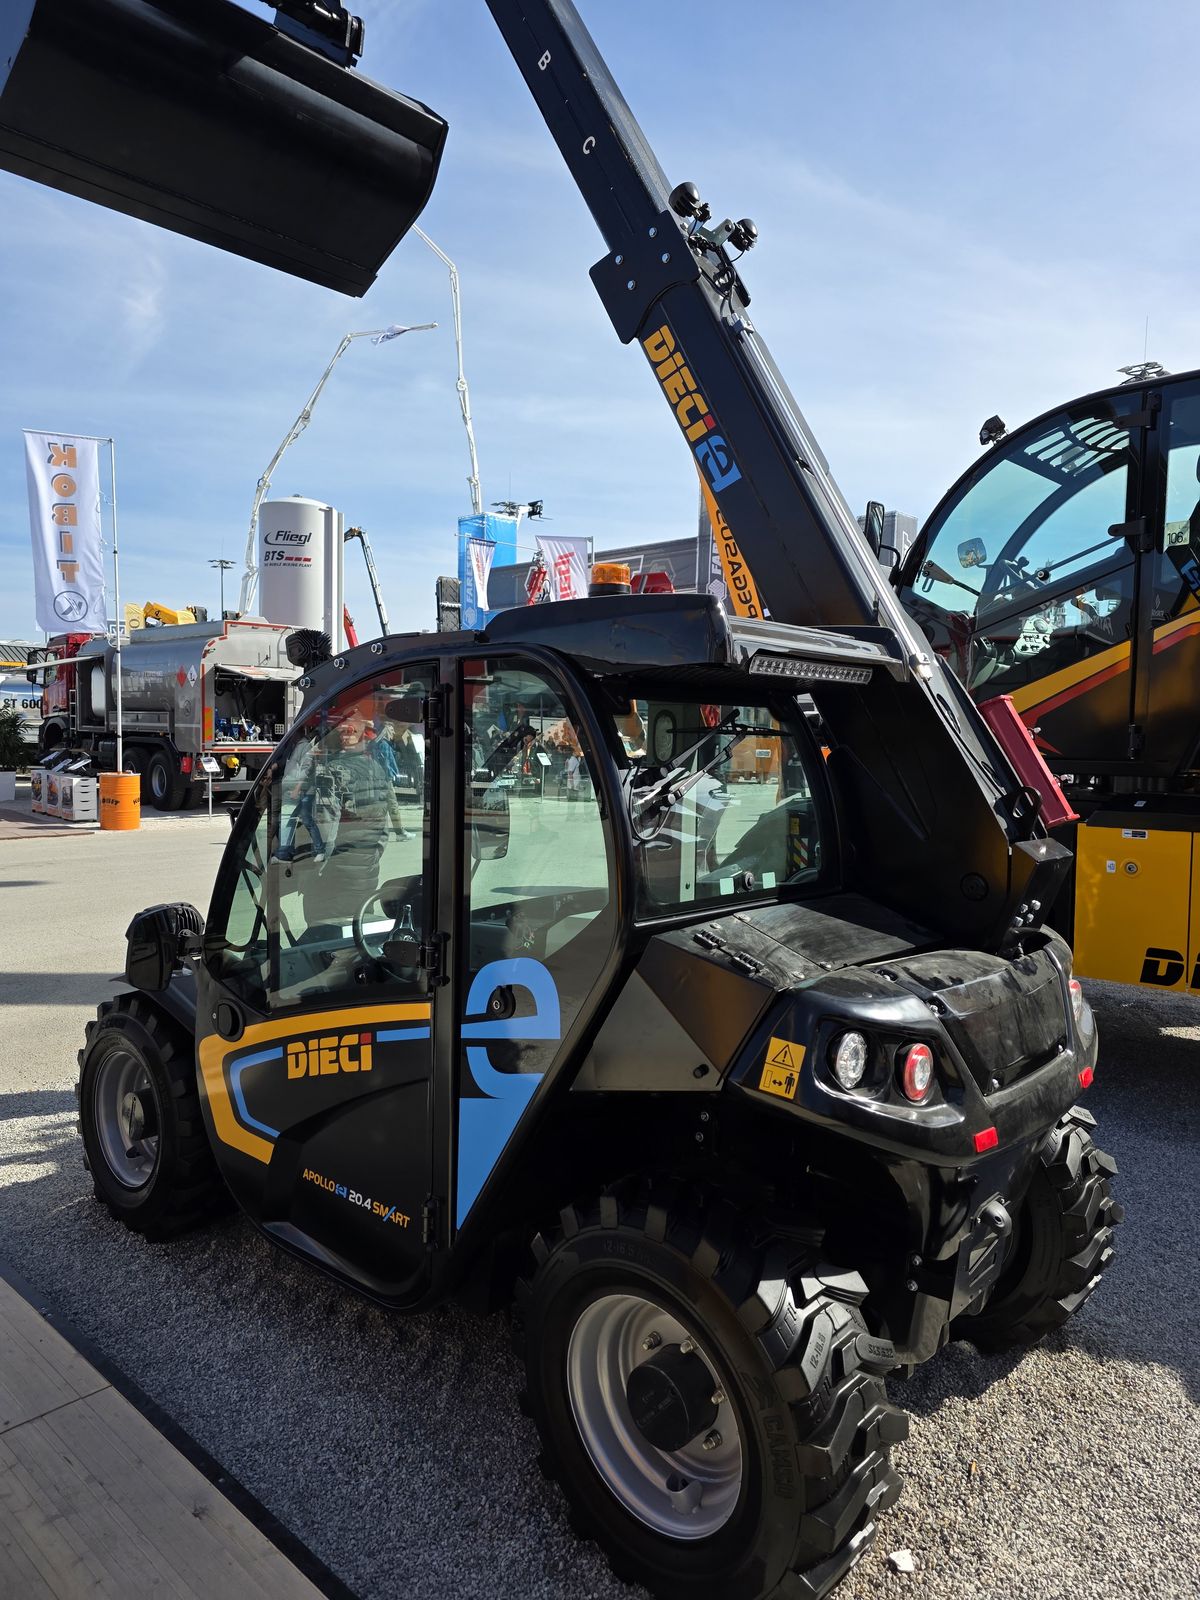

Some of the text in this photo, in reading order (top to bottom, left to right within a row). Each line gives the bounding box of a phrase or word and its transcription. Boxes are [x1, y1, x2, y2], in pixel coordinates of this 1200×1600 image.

[538, 50, 551, 71] B
[582, 136, 596, 155] C
[643, 324, 716, 442] DIECI
[275, 530, 312, 544] Fliegl
[1167, 532, 1184, 544] 106
[264, 550, 285, 561] BTS
[466, 544, 474, 604] FARES
[3, 698, 17, 708] ST
[287, 1032, 373, 1080] DIECI
[303, 1168, 335, 1192] APOLLO
[348, 1190, 372, 1210] 20.4
